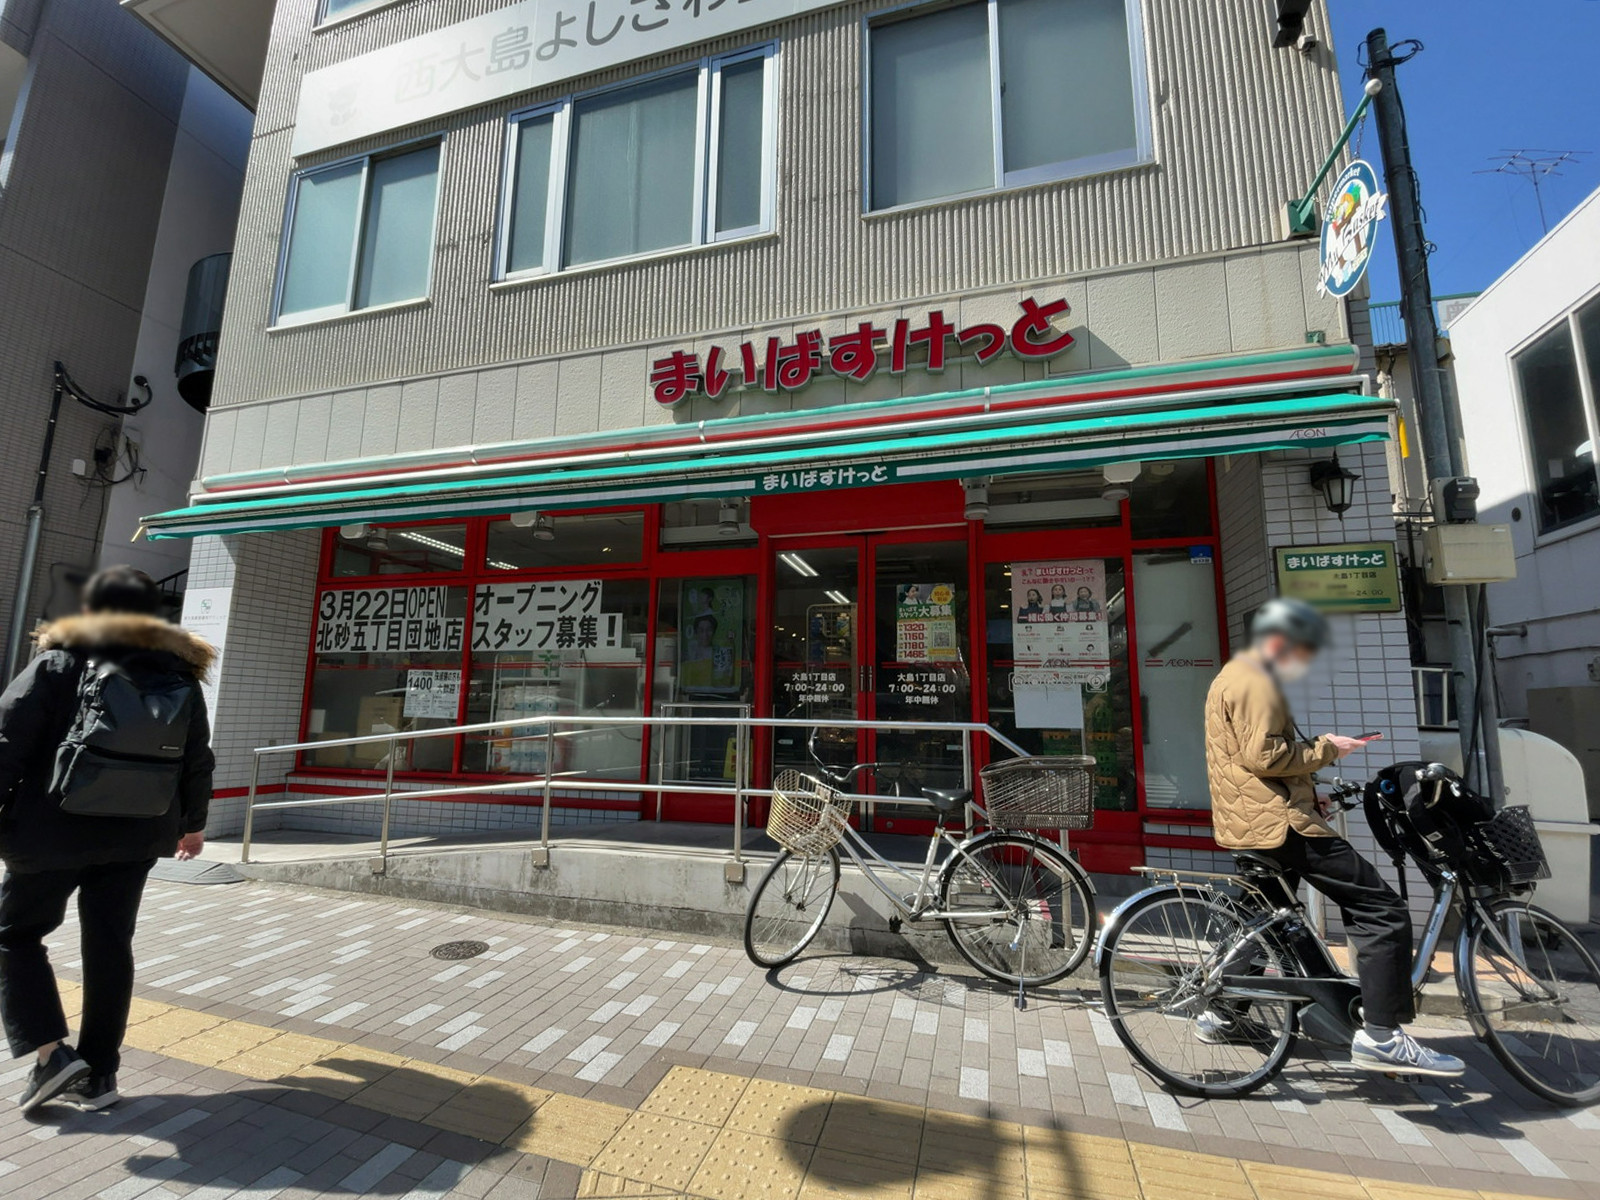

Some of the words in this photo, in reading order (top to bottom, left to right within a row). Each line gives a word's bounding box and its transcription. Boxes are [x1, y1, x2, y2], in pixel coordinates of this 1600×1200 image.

[650, 296, 1077, 407] まいばすけっと
[763, 465, 888, 491] まいばすけっと
[1287, 553, 1384, 569] まいばすけっと
[475, 580, 601, 616] オープニング
[317, 618, 462, 651] 北砂五丁目団地店
[473, 615, 617, 650] スタッフ募集!
[792, 673, 836, 681] 大島1丁目店
[897, 673, 946, 682] 大島1丁目店
[798, 694, 829, 703] 年中無休
[905, 695, 939, 705] 年中無休
